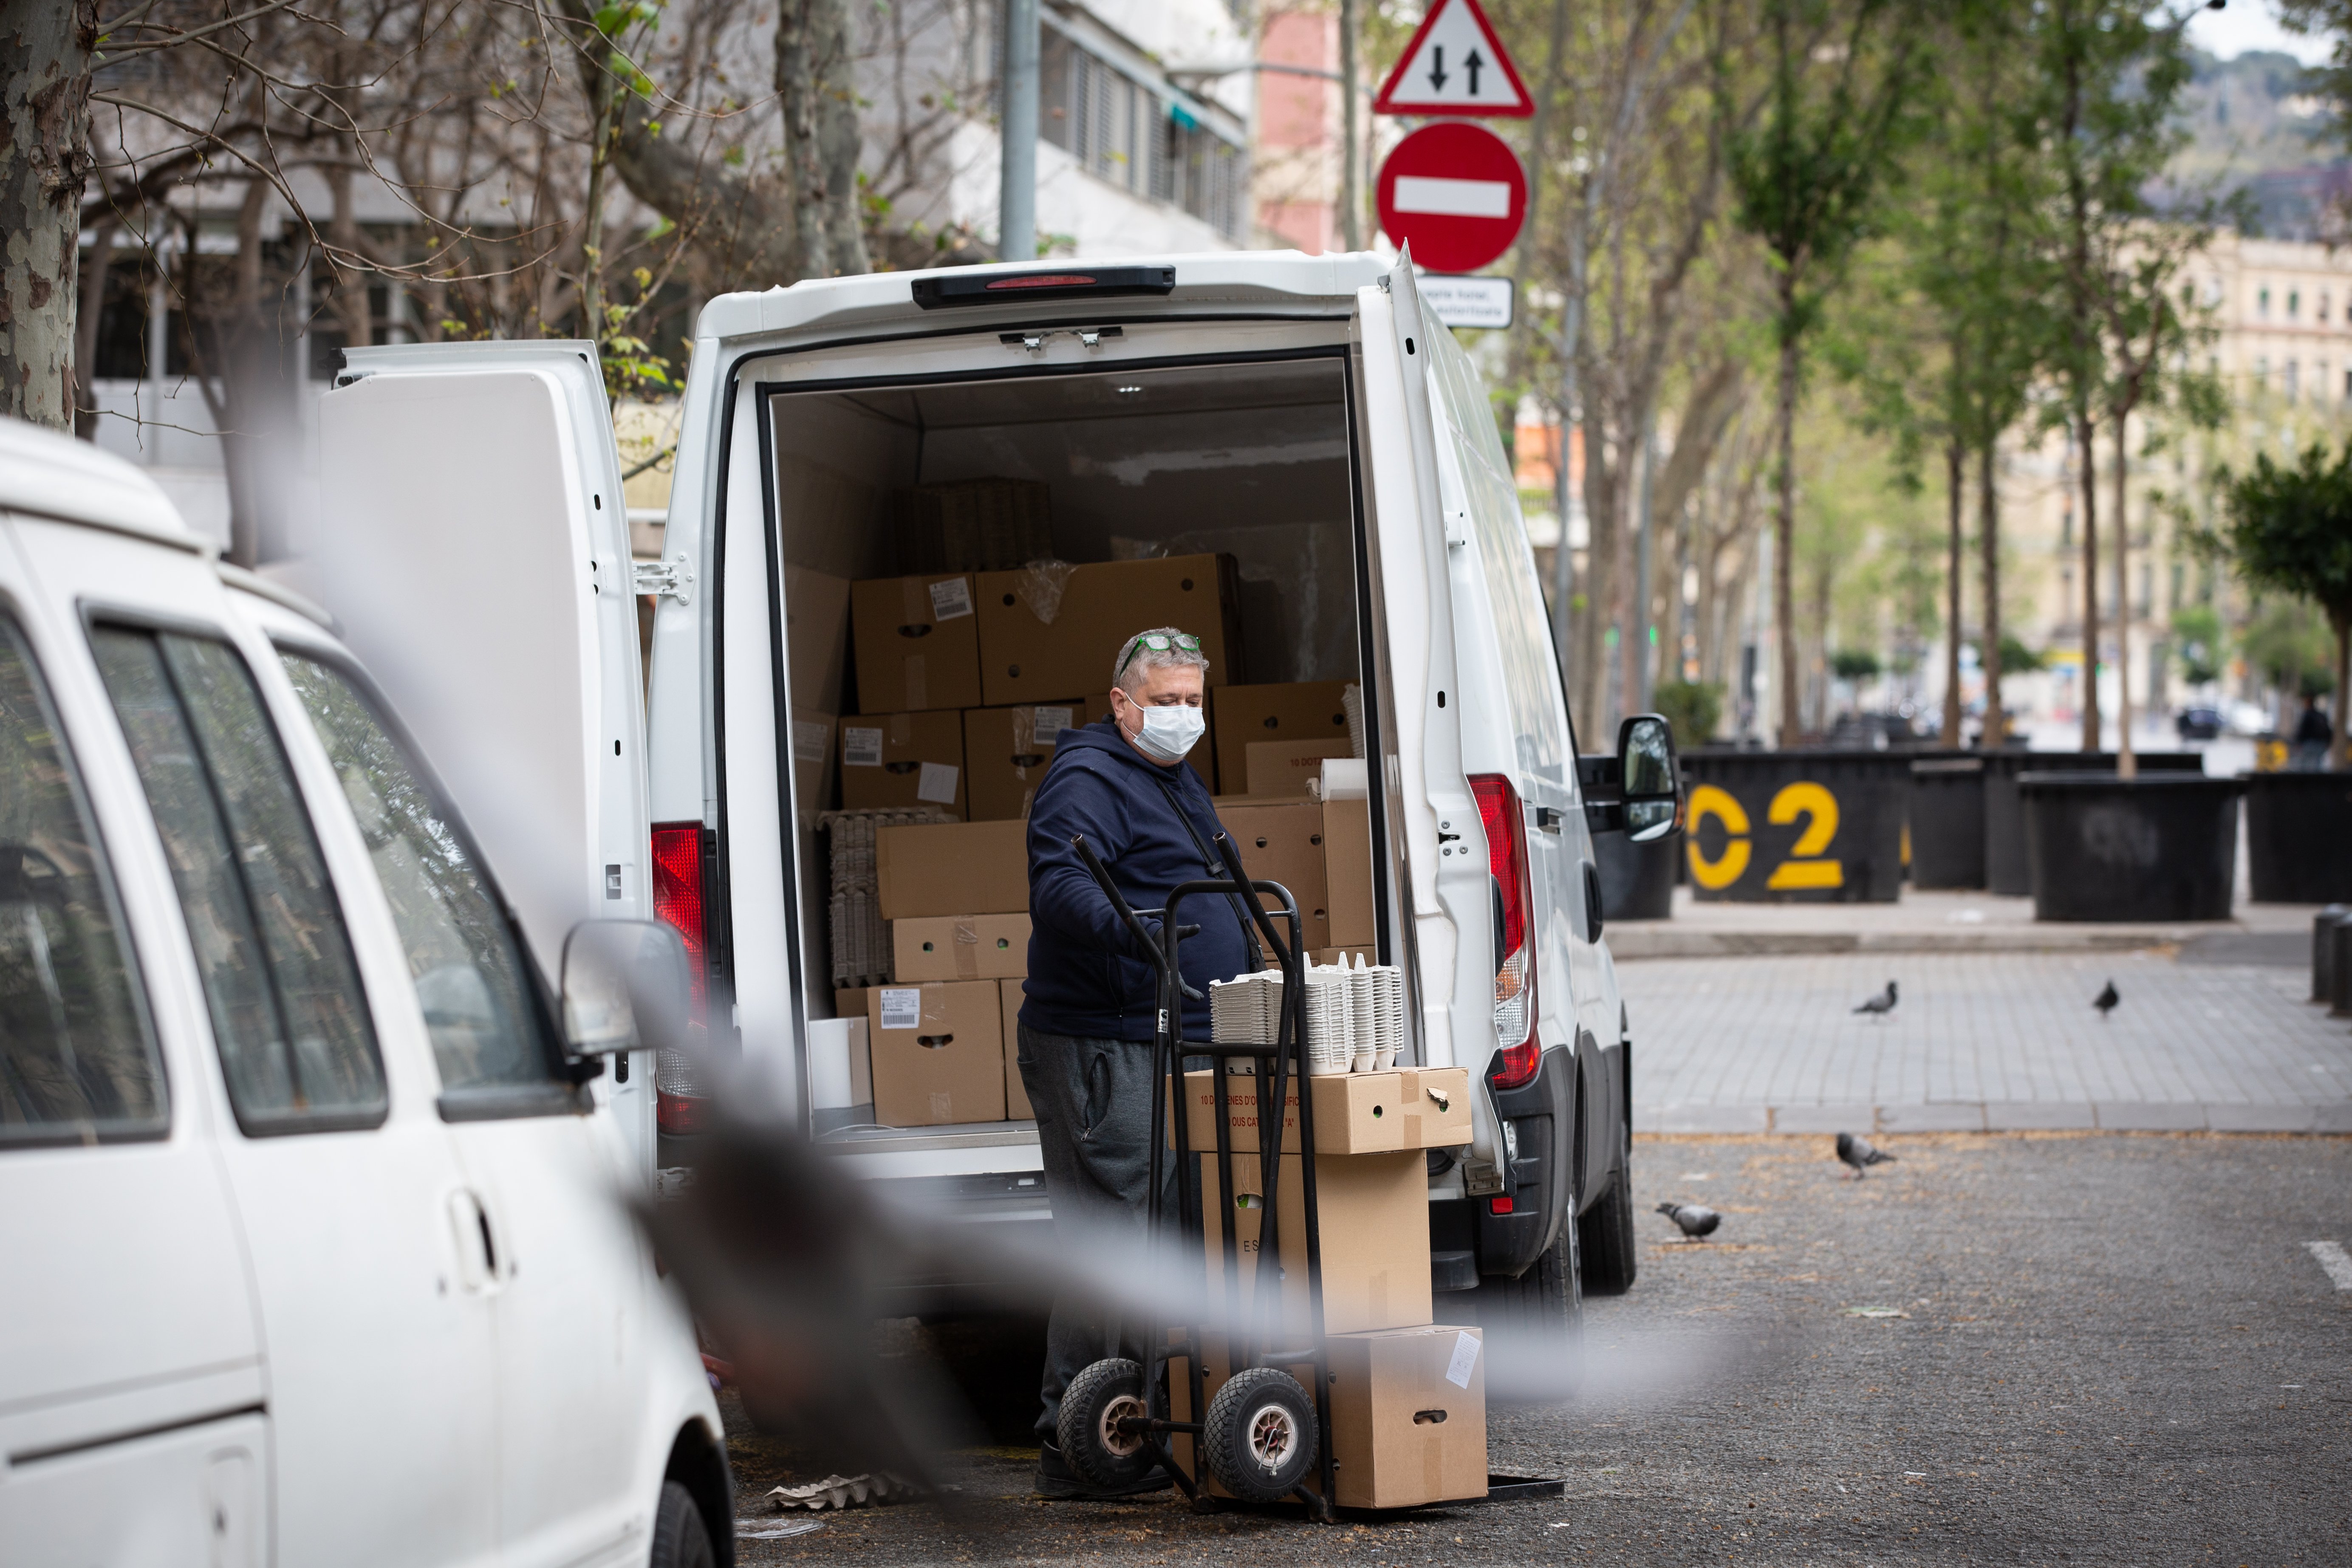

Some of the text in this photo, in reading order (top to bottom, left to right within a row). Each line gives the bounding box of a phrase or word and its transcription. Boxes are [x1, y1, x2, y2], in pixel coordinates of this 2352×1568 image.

[1201, 1095, 1208, 1105] 10
[1210, 1095, 1243, 1105] DENES
[1232, 1116, 1246, 1127] OUS
